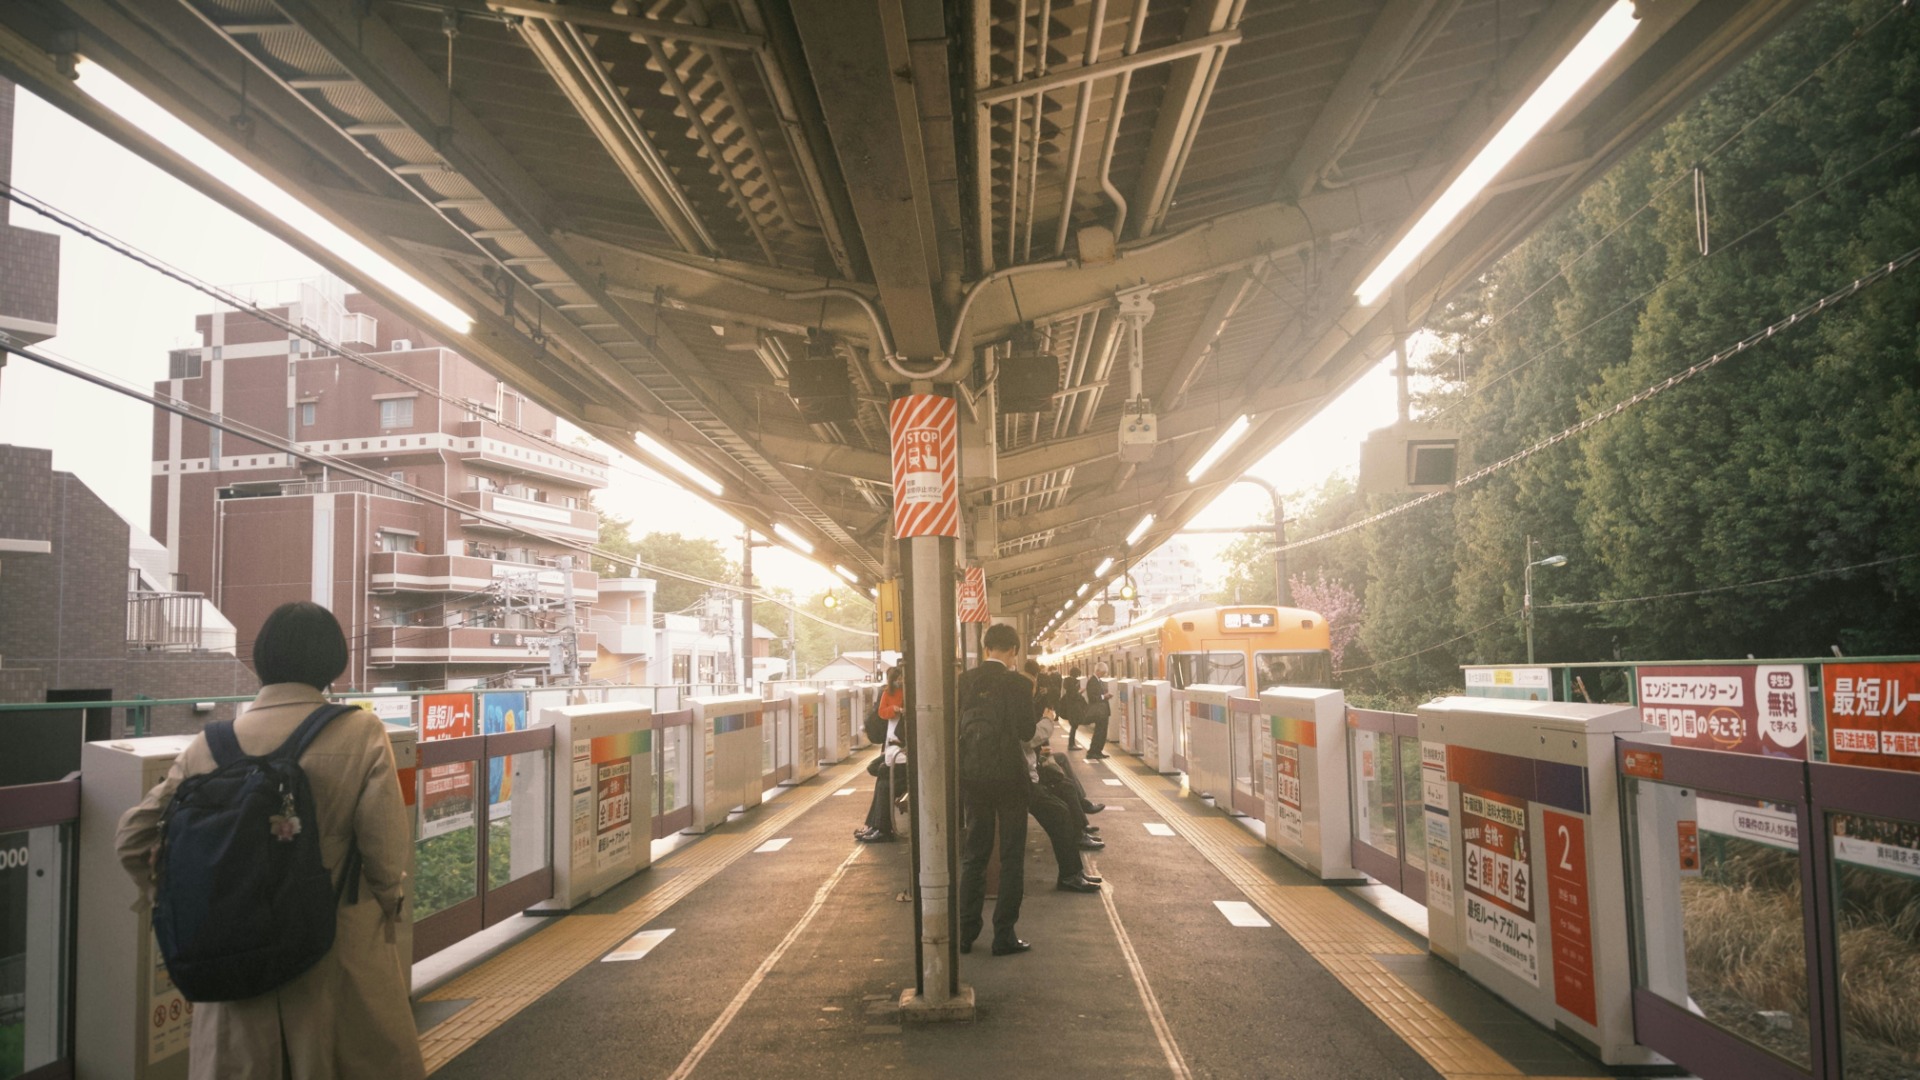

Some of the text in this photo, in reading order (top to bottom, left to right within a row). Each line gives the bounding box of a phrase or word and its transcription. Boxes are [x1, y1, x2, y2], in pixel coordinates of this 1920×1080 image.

[907, 431, 938, 444] STOP
[1645, 682, 1738, 700] エンジニアインターン
[1770, 674, 1791, 688] 学生は
[1767, 691, 1798, 718] 無料
[426, 704, 471, 730] 最短ルート
[1770, 720, 1798, 733] で学べる
[1835, 732, 1877, 750] 司法試験
[1883, 733, 1920, 754] 予備試
[1484, 823, 1504, 848] 合格で
[1557, 825, 1573, 871] 2
[1467, 849, 1528, 903] 全額返金
